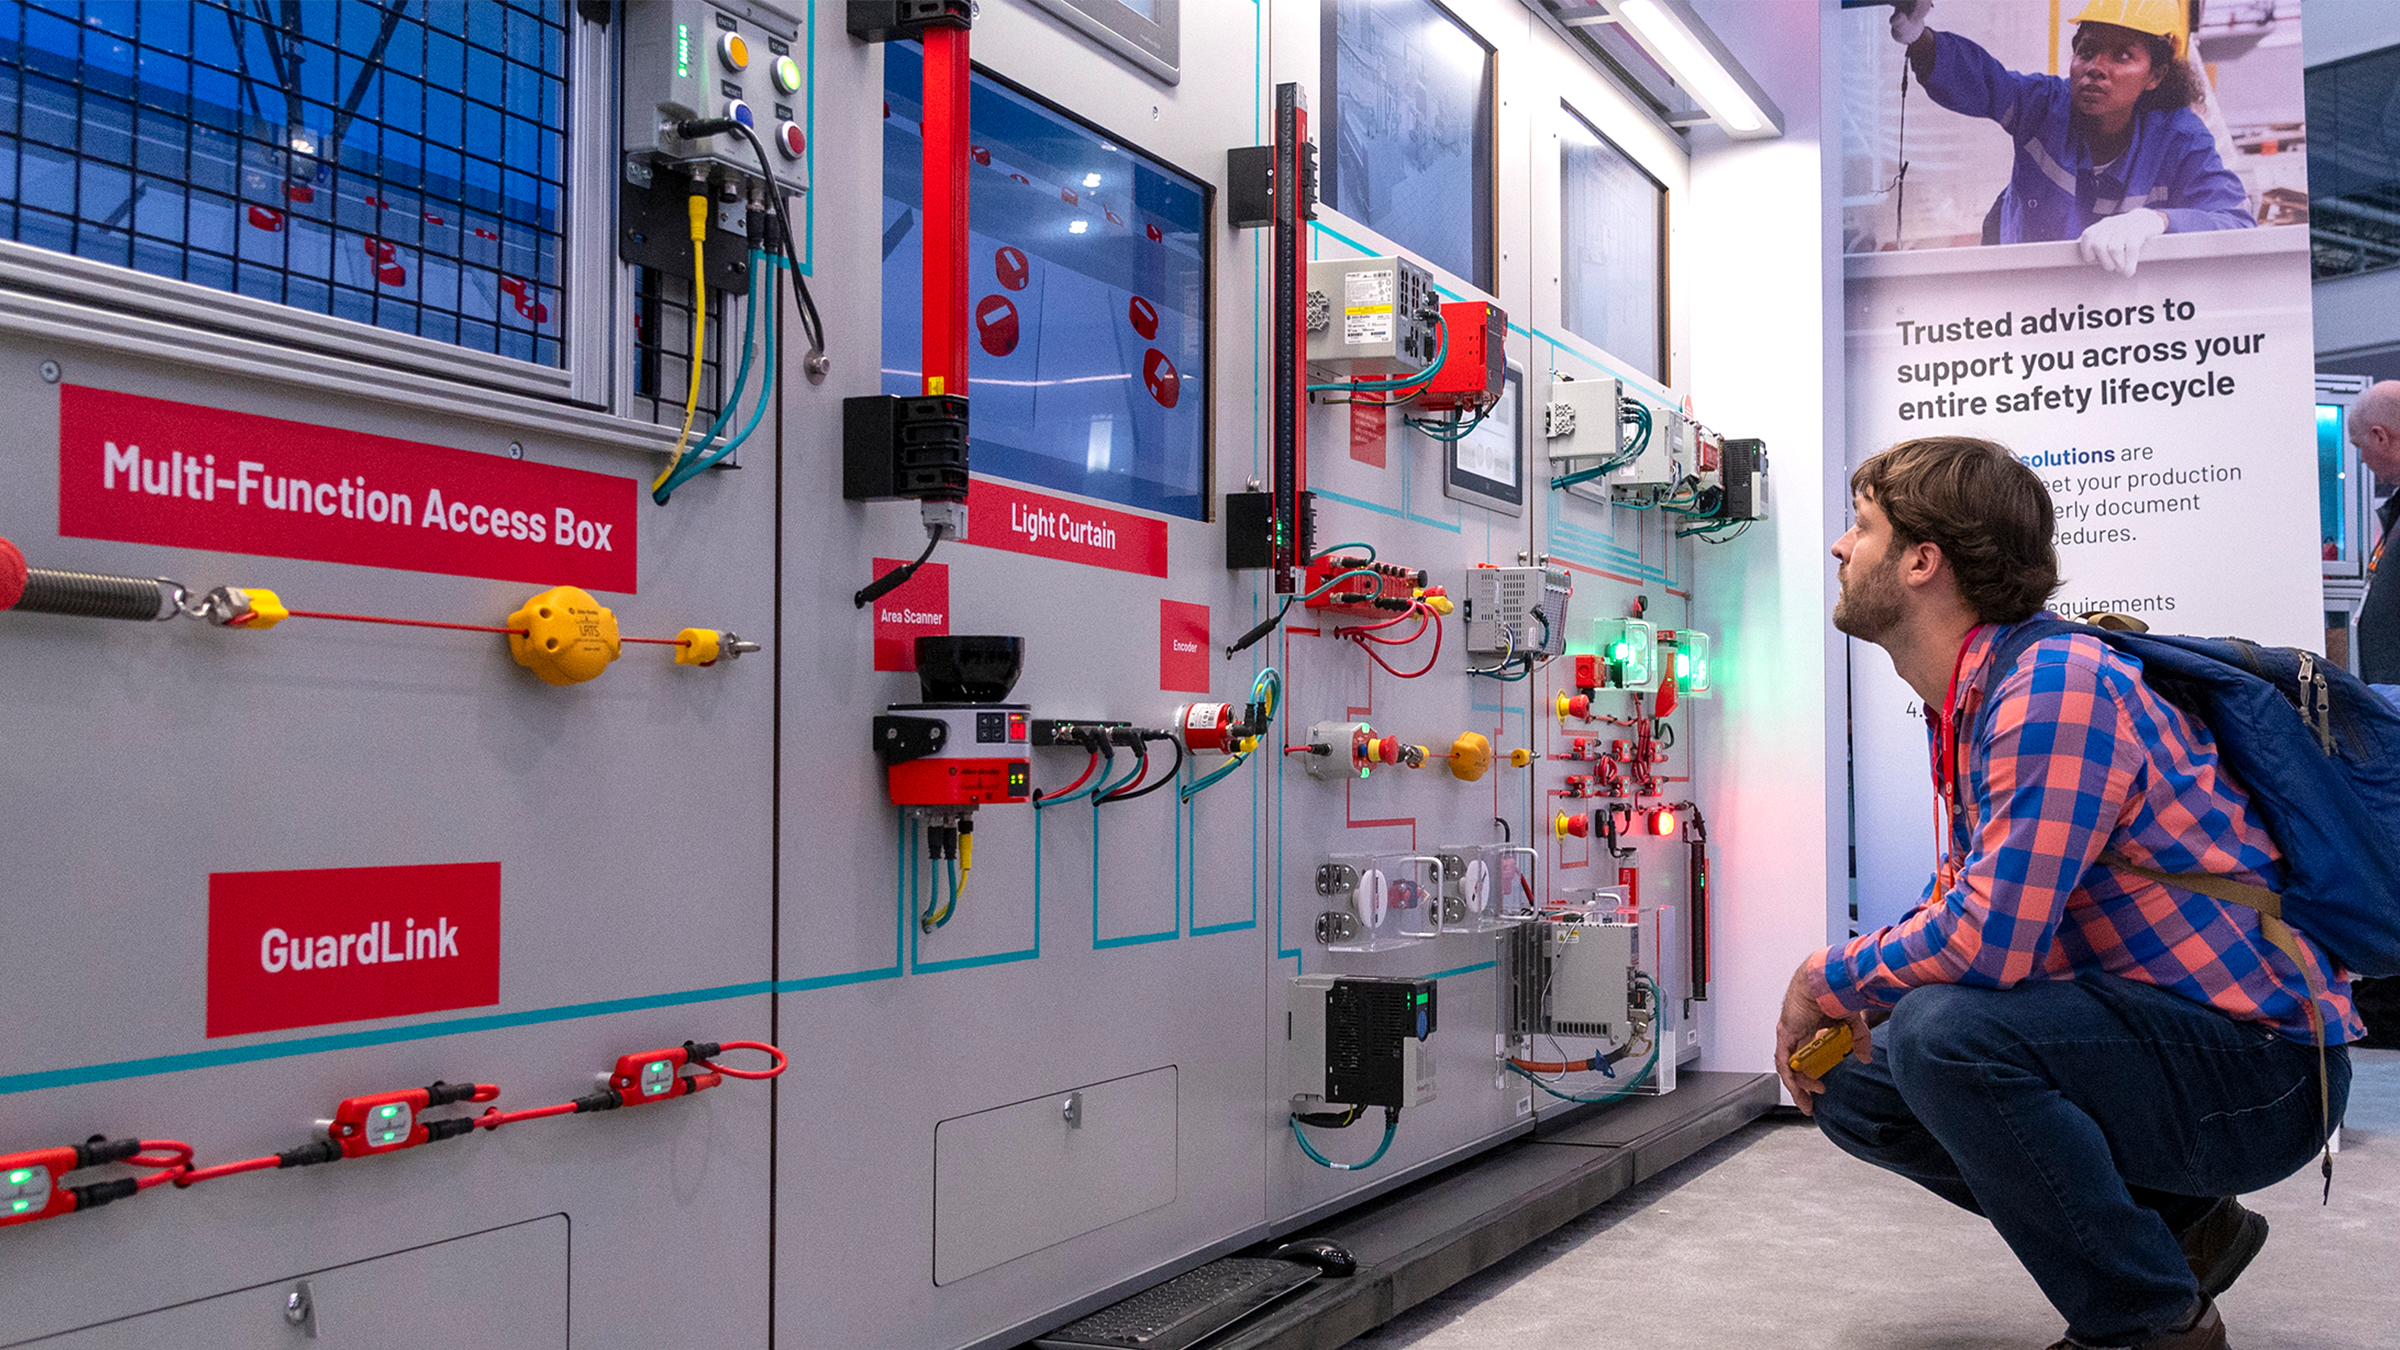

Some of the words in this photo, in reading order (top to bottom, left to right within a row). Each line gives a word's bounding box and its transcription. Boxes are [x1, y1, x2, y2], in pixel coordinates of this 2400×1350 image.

[1896, 312, 2012, 346] Trusted
[2020, 304, 2155, 335] advisors
[2162, 298, 2195, 321] to
[1897, 352, 2013, 387] support
[2021, 351, 2074, 380] you
[2082, 341, 2187, 368] across
[2195, 333, 2265, 365] your
[1898, 391, 1987, 421] entire
[1995, 385, 2092, 414] safety
[2101, 371, 2235, 406] lifecycle
[2021, 447, 2115, 468] solutions
[2120, 446, 2153, 462] are
[2042, 476, 2071, 493] eet
[2077, 475, 2121, 496] your
[2128, 464, 2241, 492] production
[103, 441, 412, 526] Multi-Function
[422, 488, 547, 543] Access
[555, 507, 612, 552] Box
[2053, 500, 2089, 522] erly
[2095, 494, 2200, 517] document
[1012, 502, 1055, 542] Light
[1059, 513, 1116, 550] Curtain
[2050, 527, 2136, 546] cedures.
[881, 608, 902, 623] Area
[903, 608, 943, 625] Scanner
[2048, 595, 2175, 619] equirements
[1173, 639, 1198, 653] Encoder
[1906, 701, 1923, 718] 4.
[261, 917, 459, 973] GuardLink
